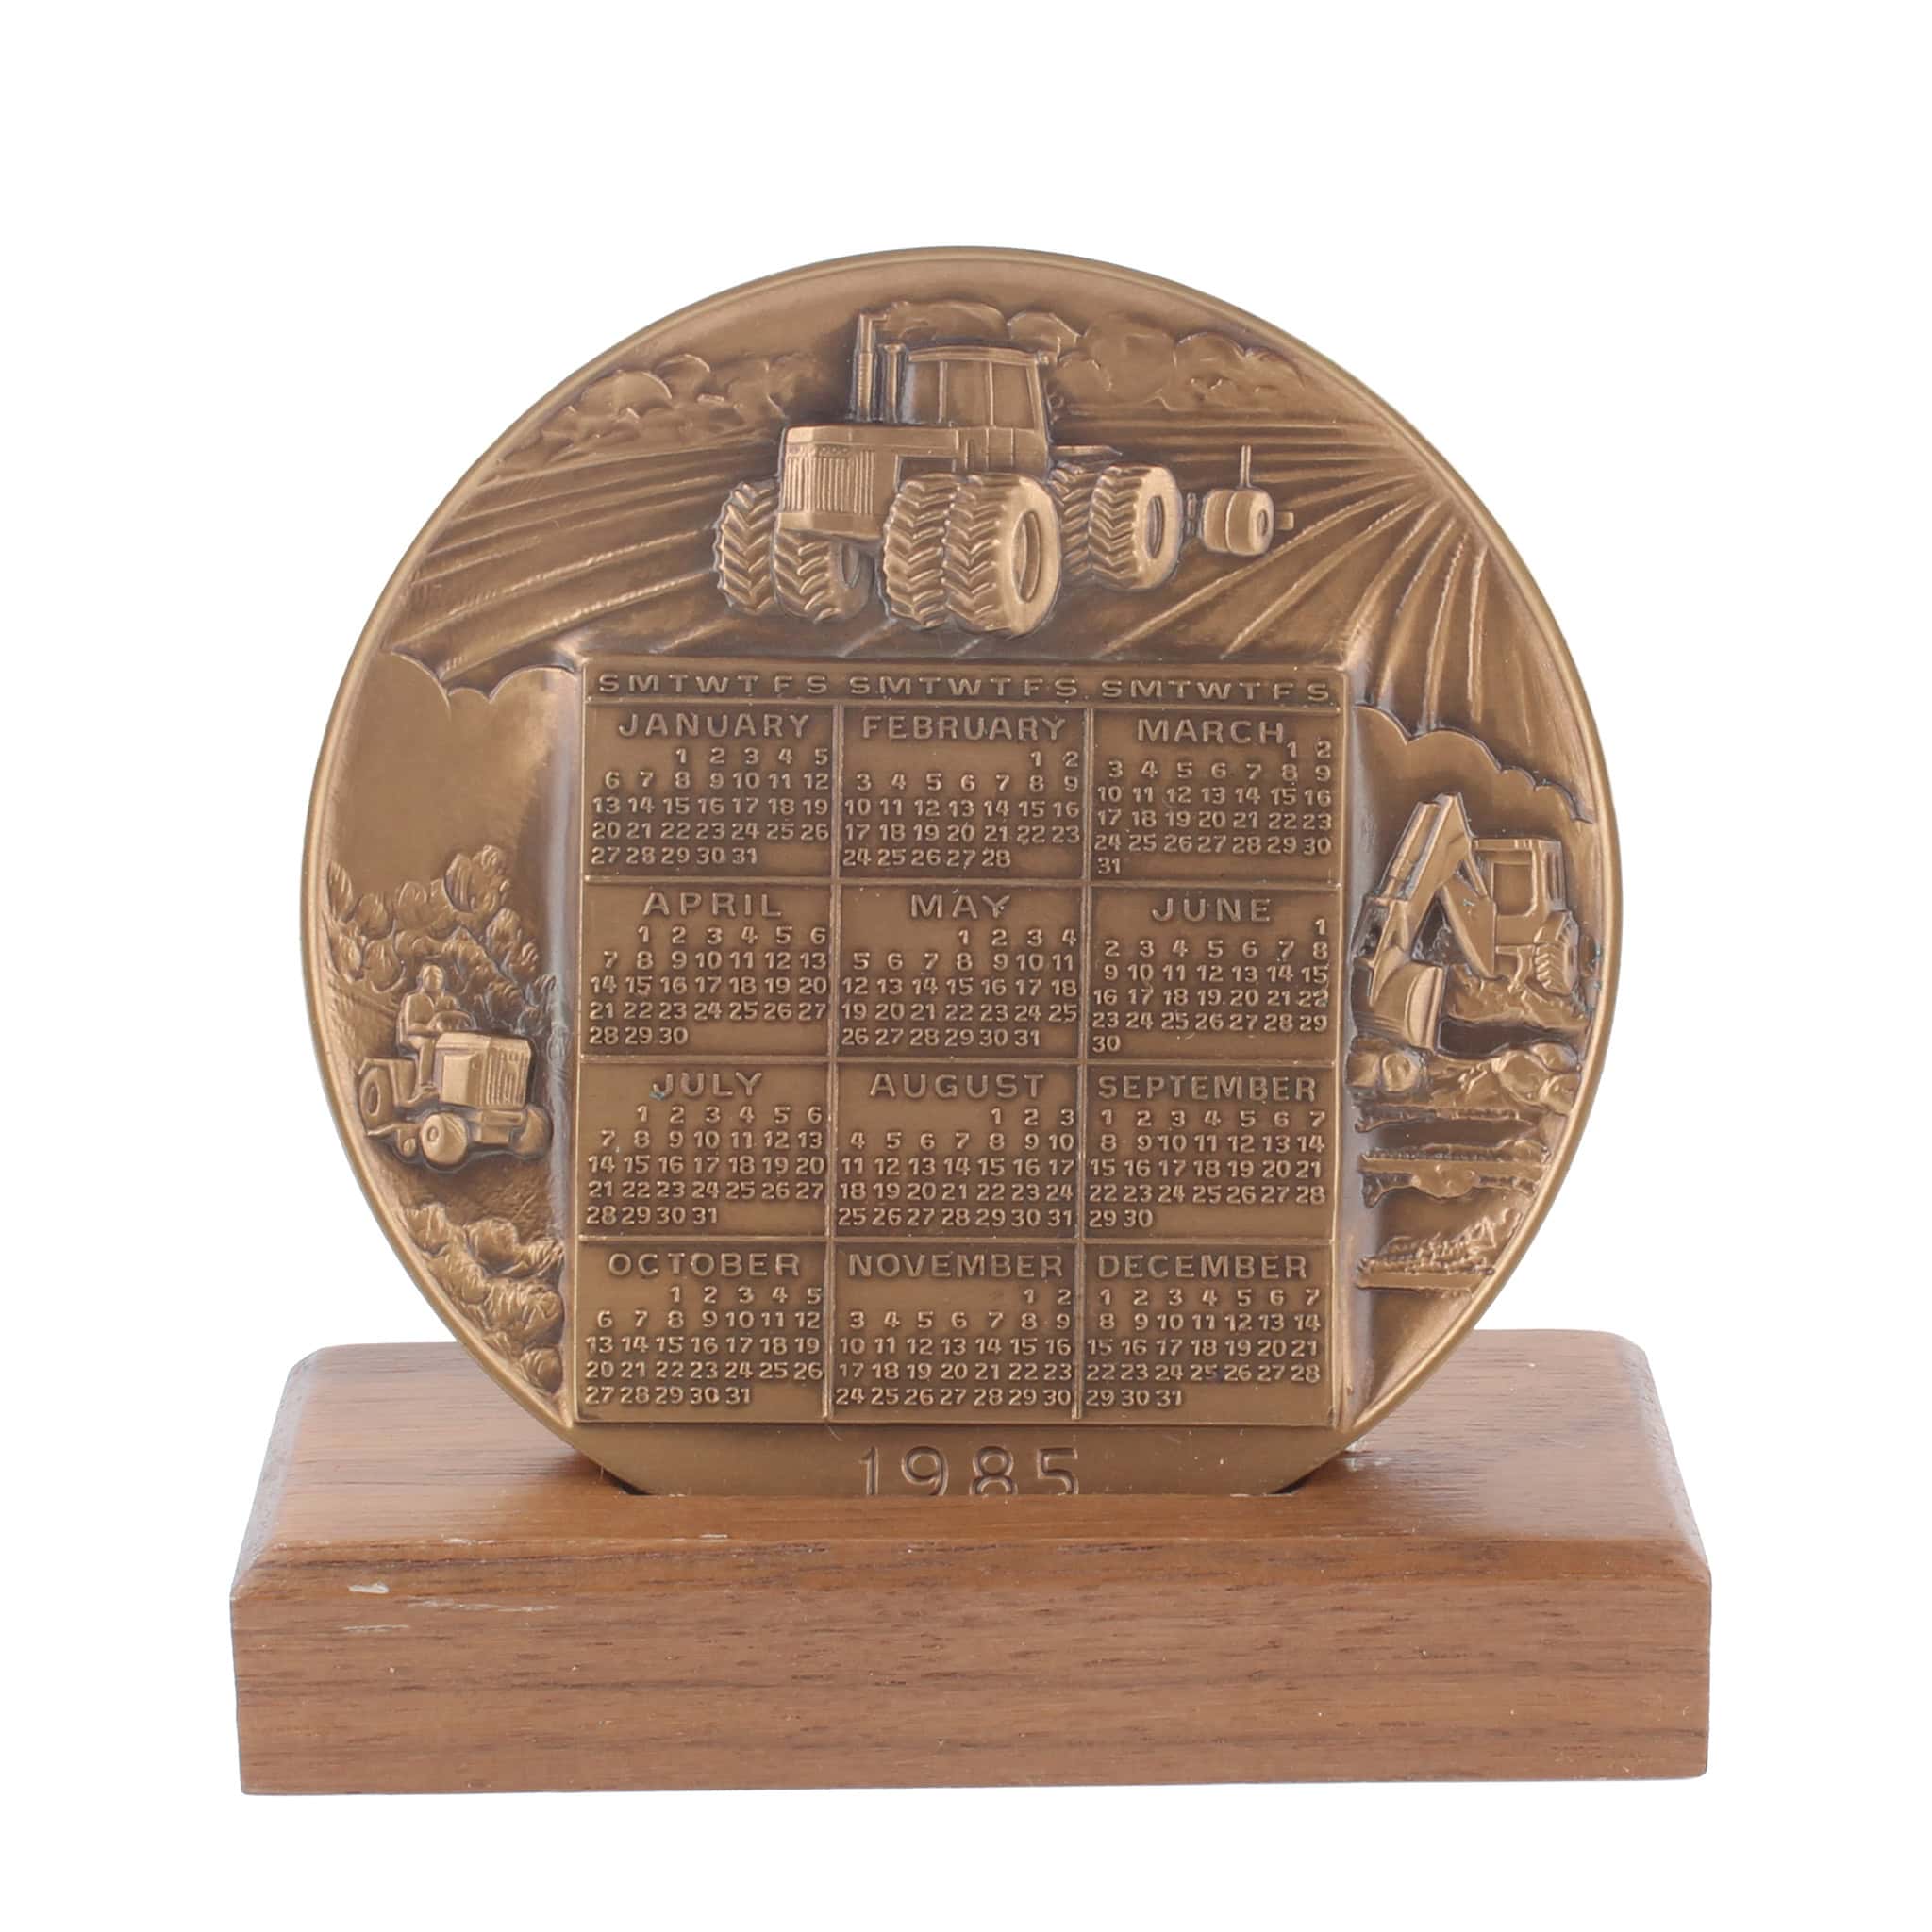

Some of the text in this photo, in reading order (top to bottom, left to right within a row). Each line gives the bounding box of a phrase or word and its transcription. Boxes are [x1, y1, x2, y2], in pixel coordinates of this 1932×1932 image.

[618, 711, 809, 739] JANUARY
[862, 715, 1066, 741] FEBRUARY
[1137, 718, 1284, 744] MARCH
[675, 746, 828, 766] 1 2 3 4 5
[1030, 750, 1079, 768] 1 2
[1286, 740, 1333, 758] 1 2
[592, 795, 828, 816] 13 14 15 16 17 18 19
[1097, 785, 1332, 807] 10 11 12 13 14 15 16
[844, 797, 1080, 818] 10 11 12 13 14 15 16
[1097, 857, 1121, 874] 31
[641, 891, 783, 917] APRIL
[910, 894, 1011, 919] MAY
[1151, 897, 1272, 923] JUNE
[958, 928, 1077, 947] 1 2 3 4
[1314, 918, 1325, 936] 1
[1103, 963, 1330, 984] 9 10 11 12 13 14 15
[590, 974, 827, 997] 14 15 16 17 18 19 20
[841, 976, 1077, 997] 12 13 14 15 16 17 18
[589, 1025, 689, 1045] 28 29 30
[1092, 1034, 1122, 1053] 30
[652, 1071, 763, 1098] JULY
[869, 1073, 1045, 1098] AUGUST
[1098, 1074, 1316, 1103] SEPTEMBER
[991, 1108, 1074, 1126] 1 2 3
[587, 1154, 824, 1178] 14 15 16 17 18 19 20
[841, 1157, 1074, 1177] 11 12 13 14 15 16 17
[1090, 1158, 1322, 1179] 15 16 17 18 19 20 21
[1089, 1208, 1154, 1228] 29 30
[608, 1252, 800, 1277] OCTOBER
[848, 1250, 1063, 1279] NOVEMBER
[1098, 1254, 1307, 1279] DECEMBER
[669, 1285, 822, 1305] 1 2 3 4 5
[1023, 1288, 1072, 1306] 1 2
[584, 1335, 820, 1356] 13 14 15 16 17 18 19
[840, 1336, 1072, 1357] 10 11 12 13 14 15 16
[1087, 1338, 1317, 1358] 15 16 17 18 19 20 21
[858, 1444, 1080, 1495] 1985
